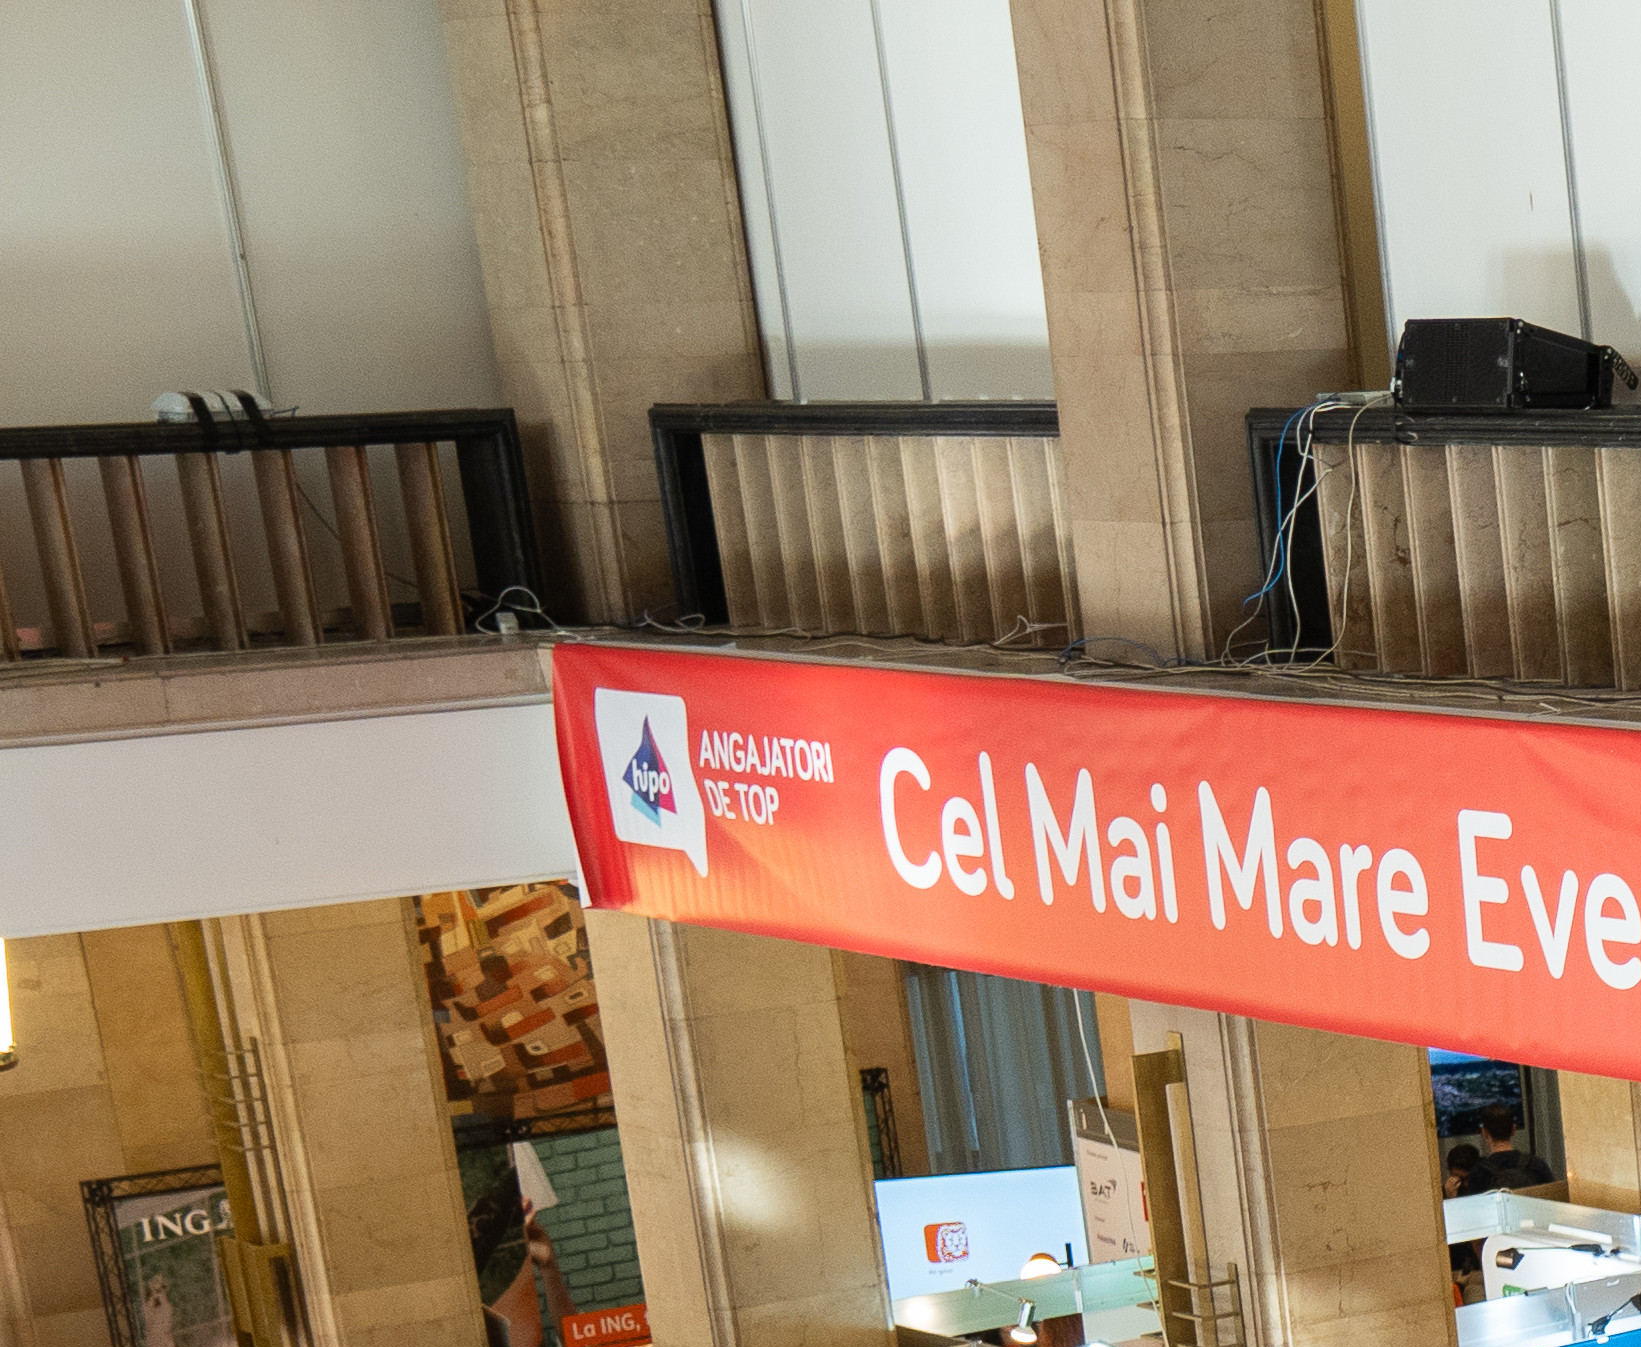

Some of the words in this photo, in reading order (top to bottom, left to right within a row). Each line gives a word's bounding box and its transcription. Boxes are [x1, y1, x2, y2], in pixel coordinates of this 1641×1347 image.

[699, 730, 834, 783] ANGAJATORI
[632, 759, 670, 802] hipo
[704, 780, 736, 819] DE
[734, 783, 779, 825] TOP
[879, 747, 1014, 900] Cel
[1026, 762, 1179, 923] Mai
[1198, 780, 1430, 959] Mare
[141, 1208, 213, 1243] ING
[572, 1320, 596, 1341] La
[599, 1311, 643, 1338] ING,
